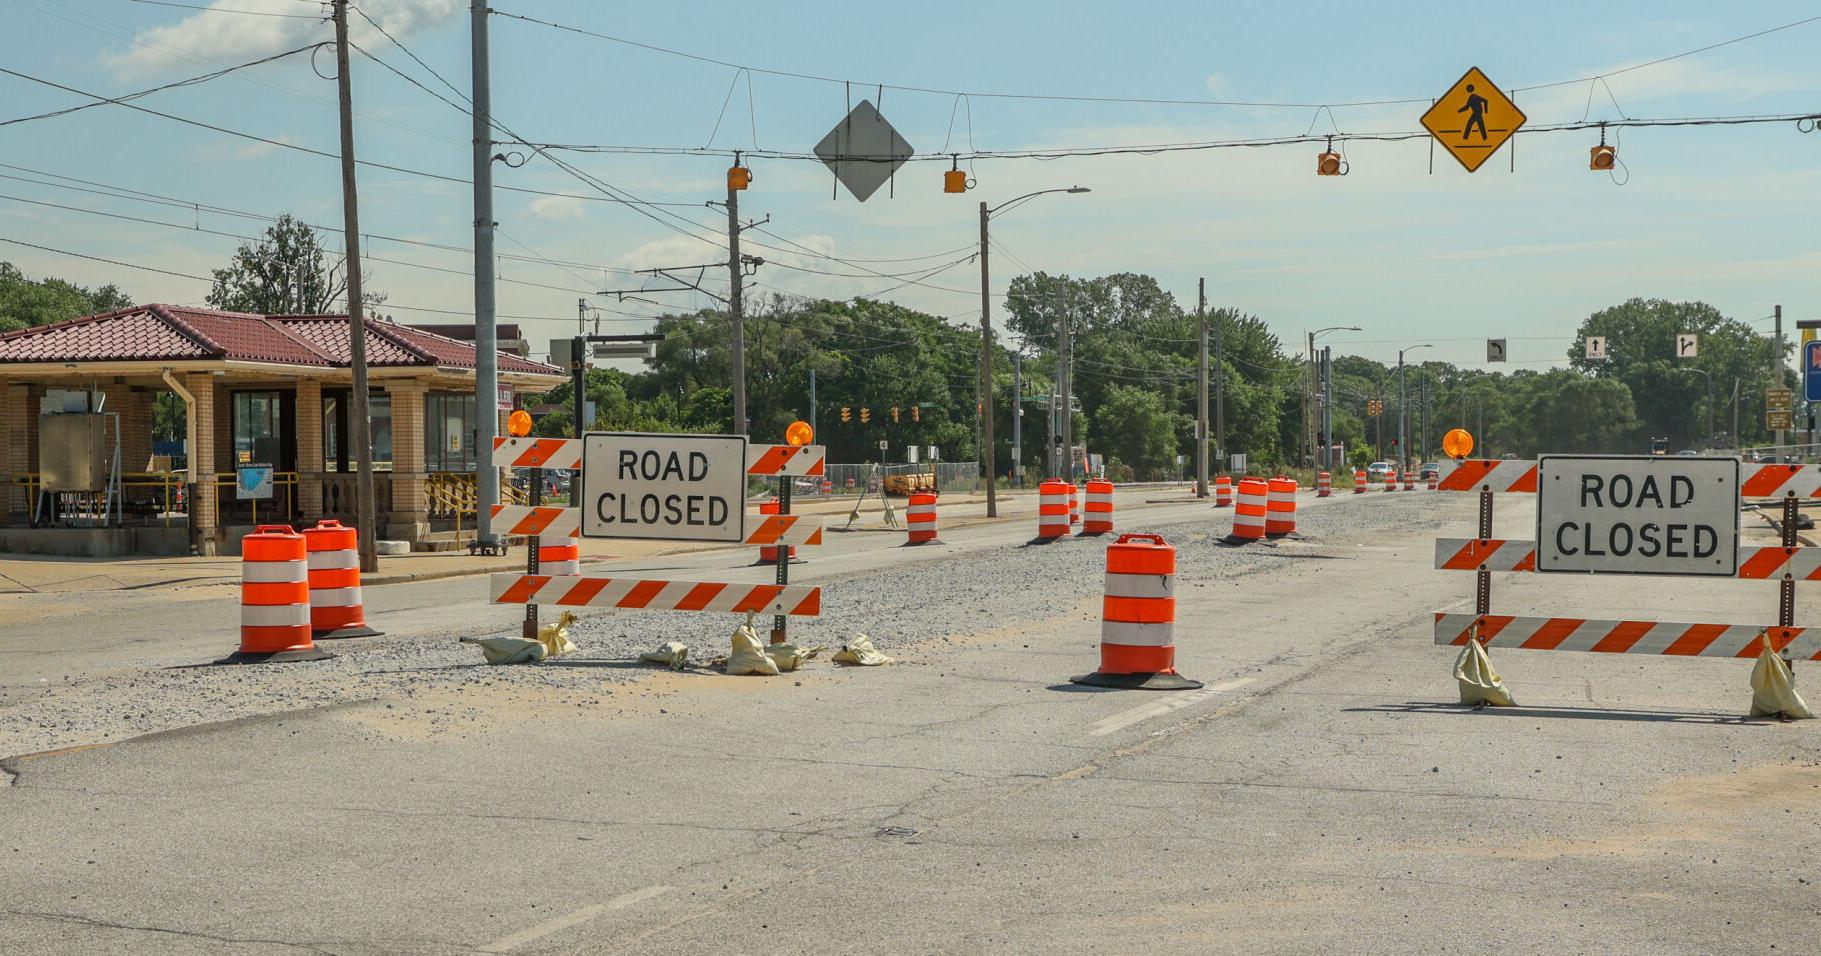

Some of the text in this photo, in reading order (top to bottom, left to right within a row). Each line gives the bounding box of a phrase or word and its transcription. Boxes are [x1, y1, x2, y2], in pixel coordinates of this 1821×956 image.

[619, 450, 709, 482] ROAD
[1580, 474, 1695, 508] ROAD
[597, 492, 728, 526] CLOSED
[1556, 521, 1718, 558] CLOSED
